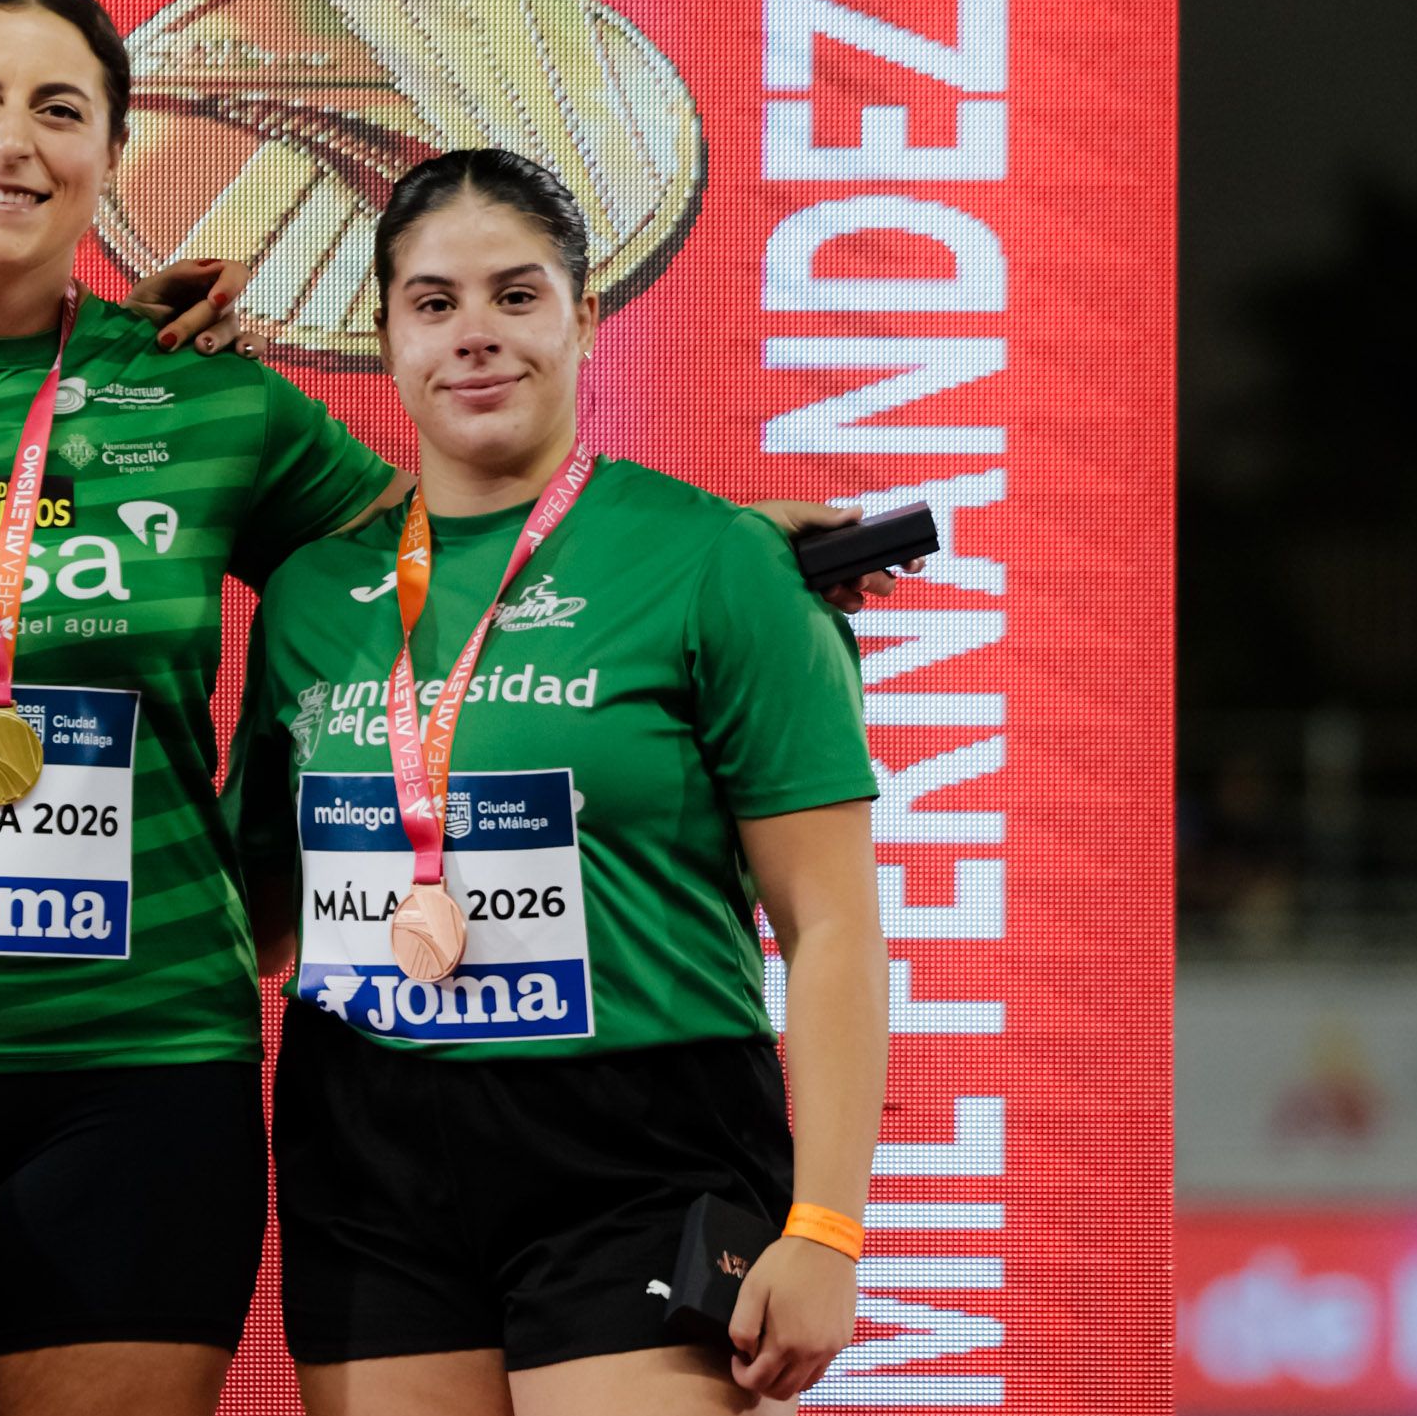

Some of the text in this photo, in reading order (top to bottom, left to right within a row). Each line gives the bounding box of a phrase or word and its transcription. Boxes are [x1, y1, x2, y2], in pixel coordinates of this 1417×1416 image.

[101, 449, 170, 465] Castelló
[4, 444, 42, 556] ATLETISMO
[537, 487, 575, 532] RFEA
[64, 616, 129, 636] agua
[52, 715, 97, 729] Ciudad
[52, 732, 114, 748] de Málaga
[400, 738, 424, 799] RFEA
[477, 800, 526, 814] Ciudad
[32, 802, 119, 838] 2026
[478, 815, 549, 831] de Málaga
[314, 881, 566, 921] MÁLA 2026
